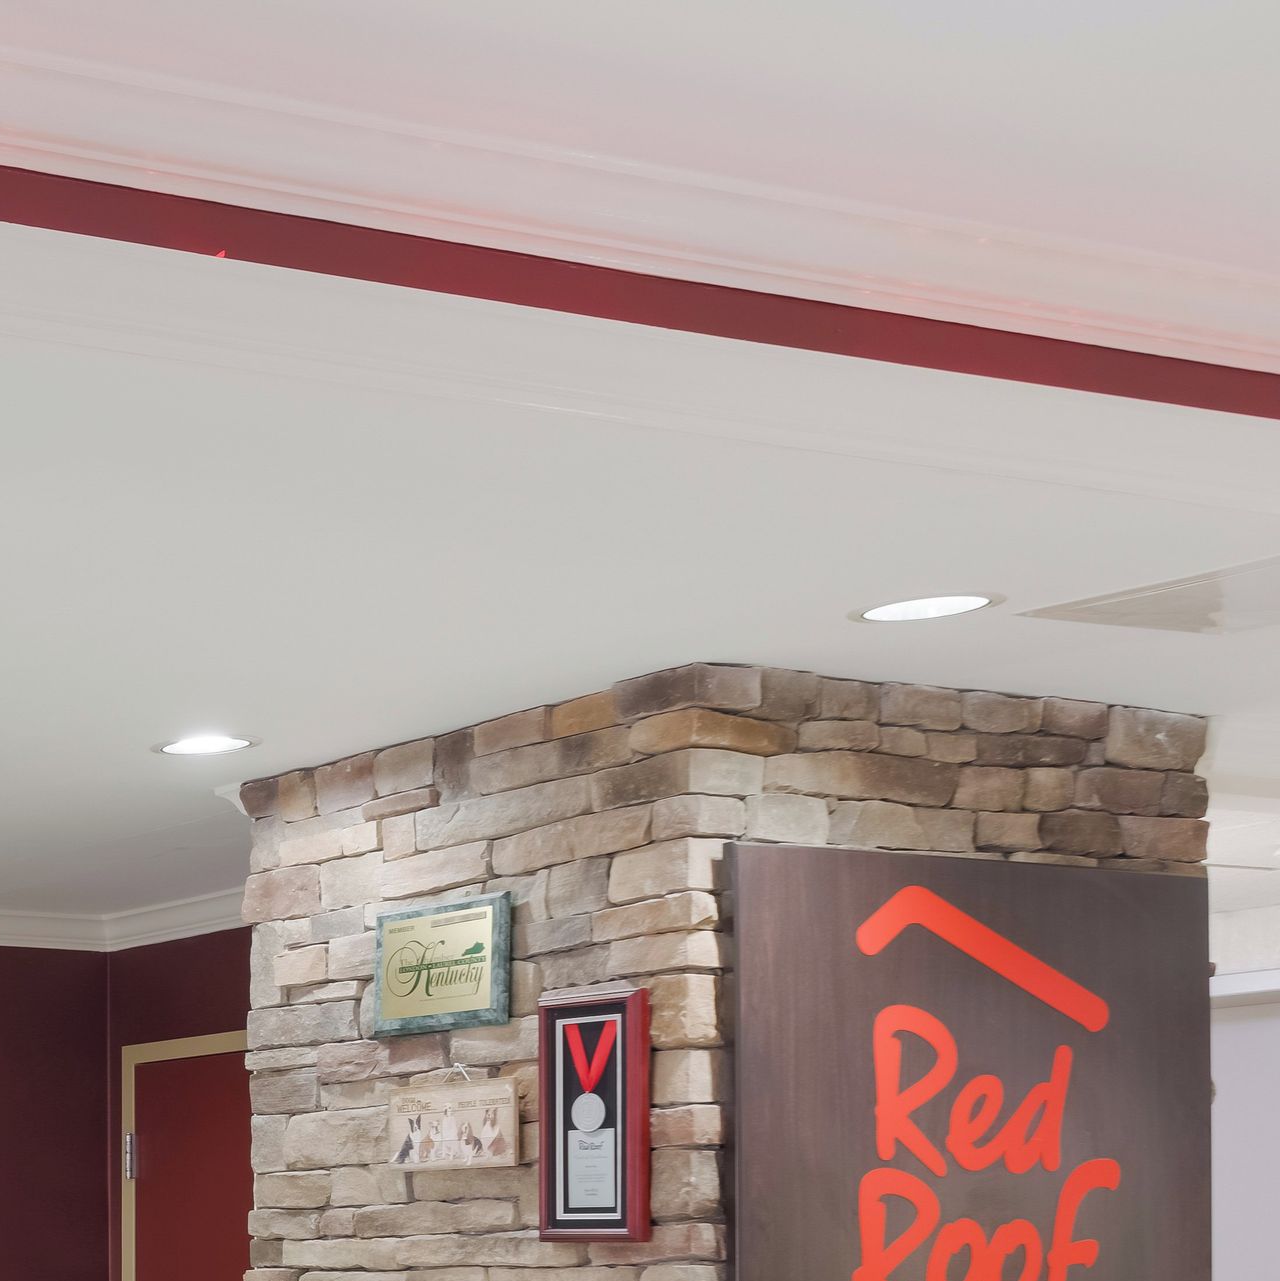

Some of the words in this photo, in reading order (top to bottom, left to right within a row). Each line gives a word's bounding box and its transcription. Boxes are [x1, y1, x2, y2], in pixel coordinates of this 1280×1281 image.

[388, 925, 415, 934] MEMBER
[386, 940, 483, 997] Kentucky
[397, 1101, 432, 1113] WELCOME
[873, 1004, 1072, 1177] Red
